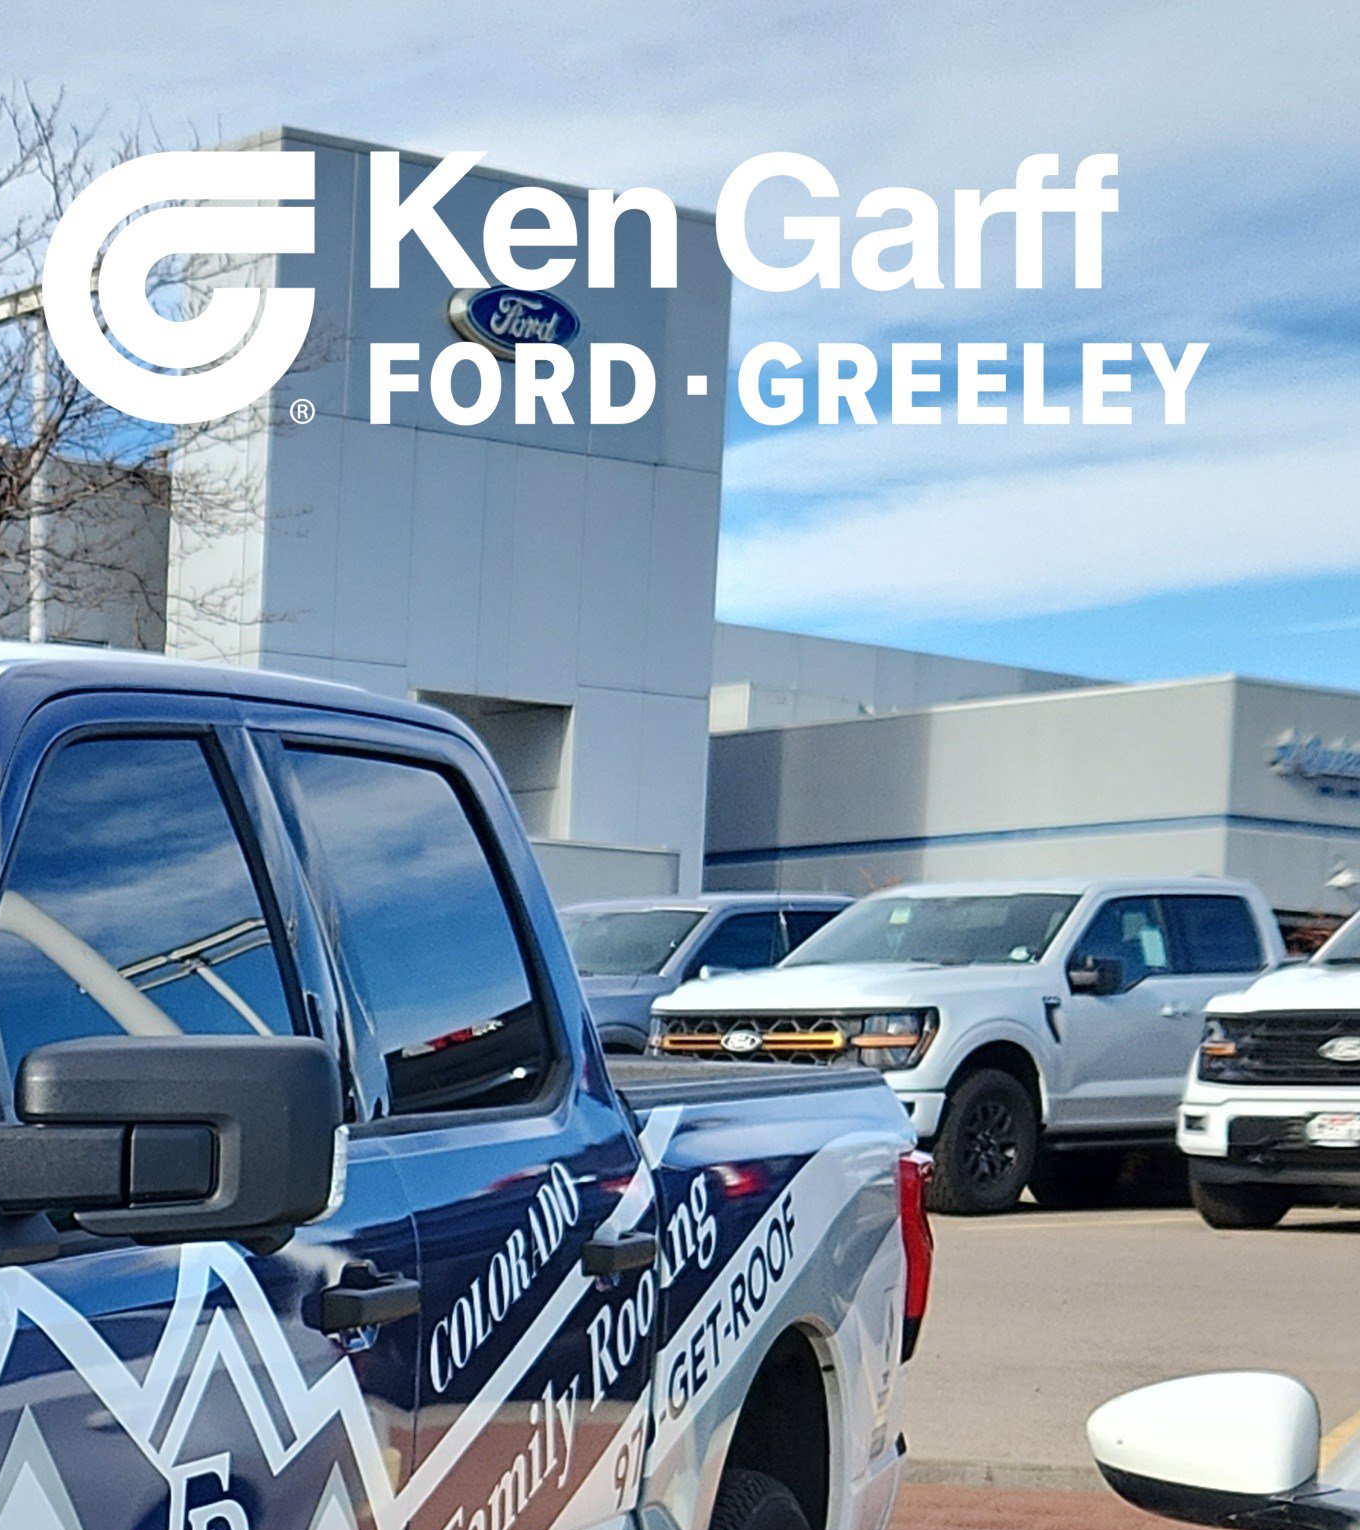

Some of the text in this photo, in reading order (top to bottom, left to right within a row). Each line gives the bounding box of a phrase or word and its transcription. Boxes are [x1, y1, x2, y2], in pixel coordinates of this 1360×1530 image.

[490, 294, 561, 342] Ford
[429, 1160, 581, 1395] COLORADO
[589, 1171, 719, 1413] Roong
